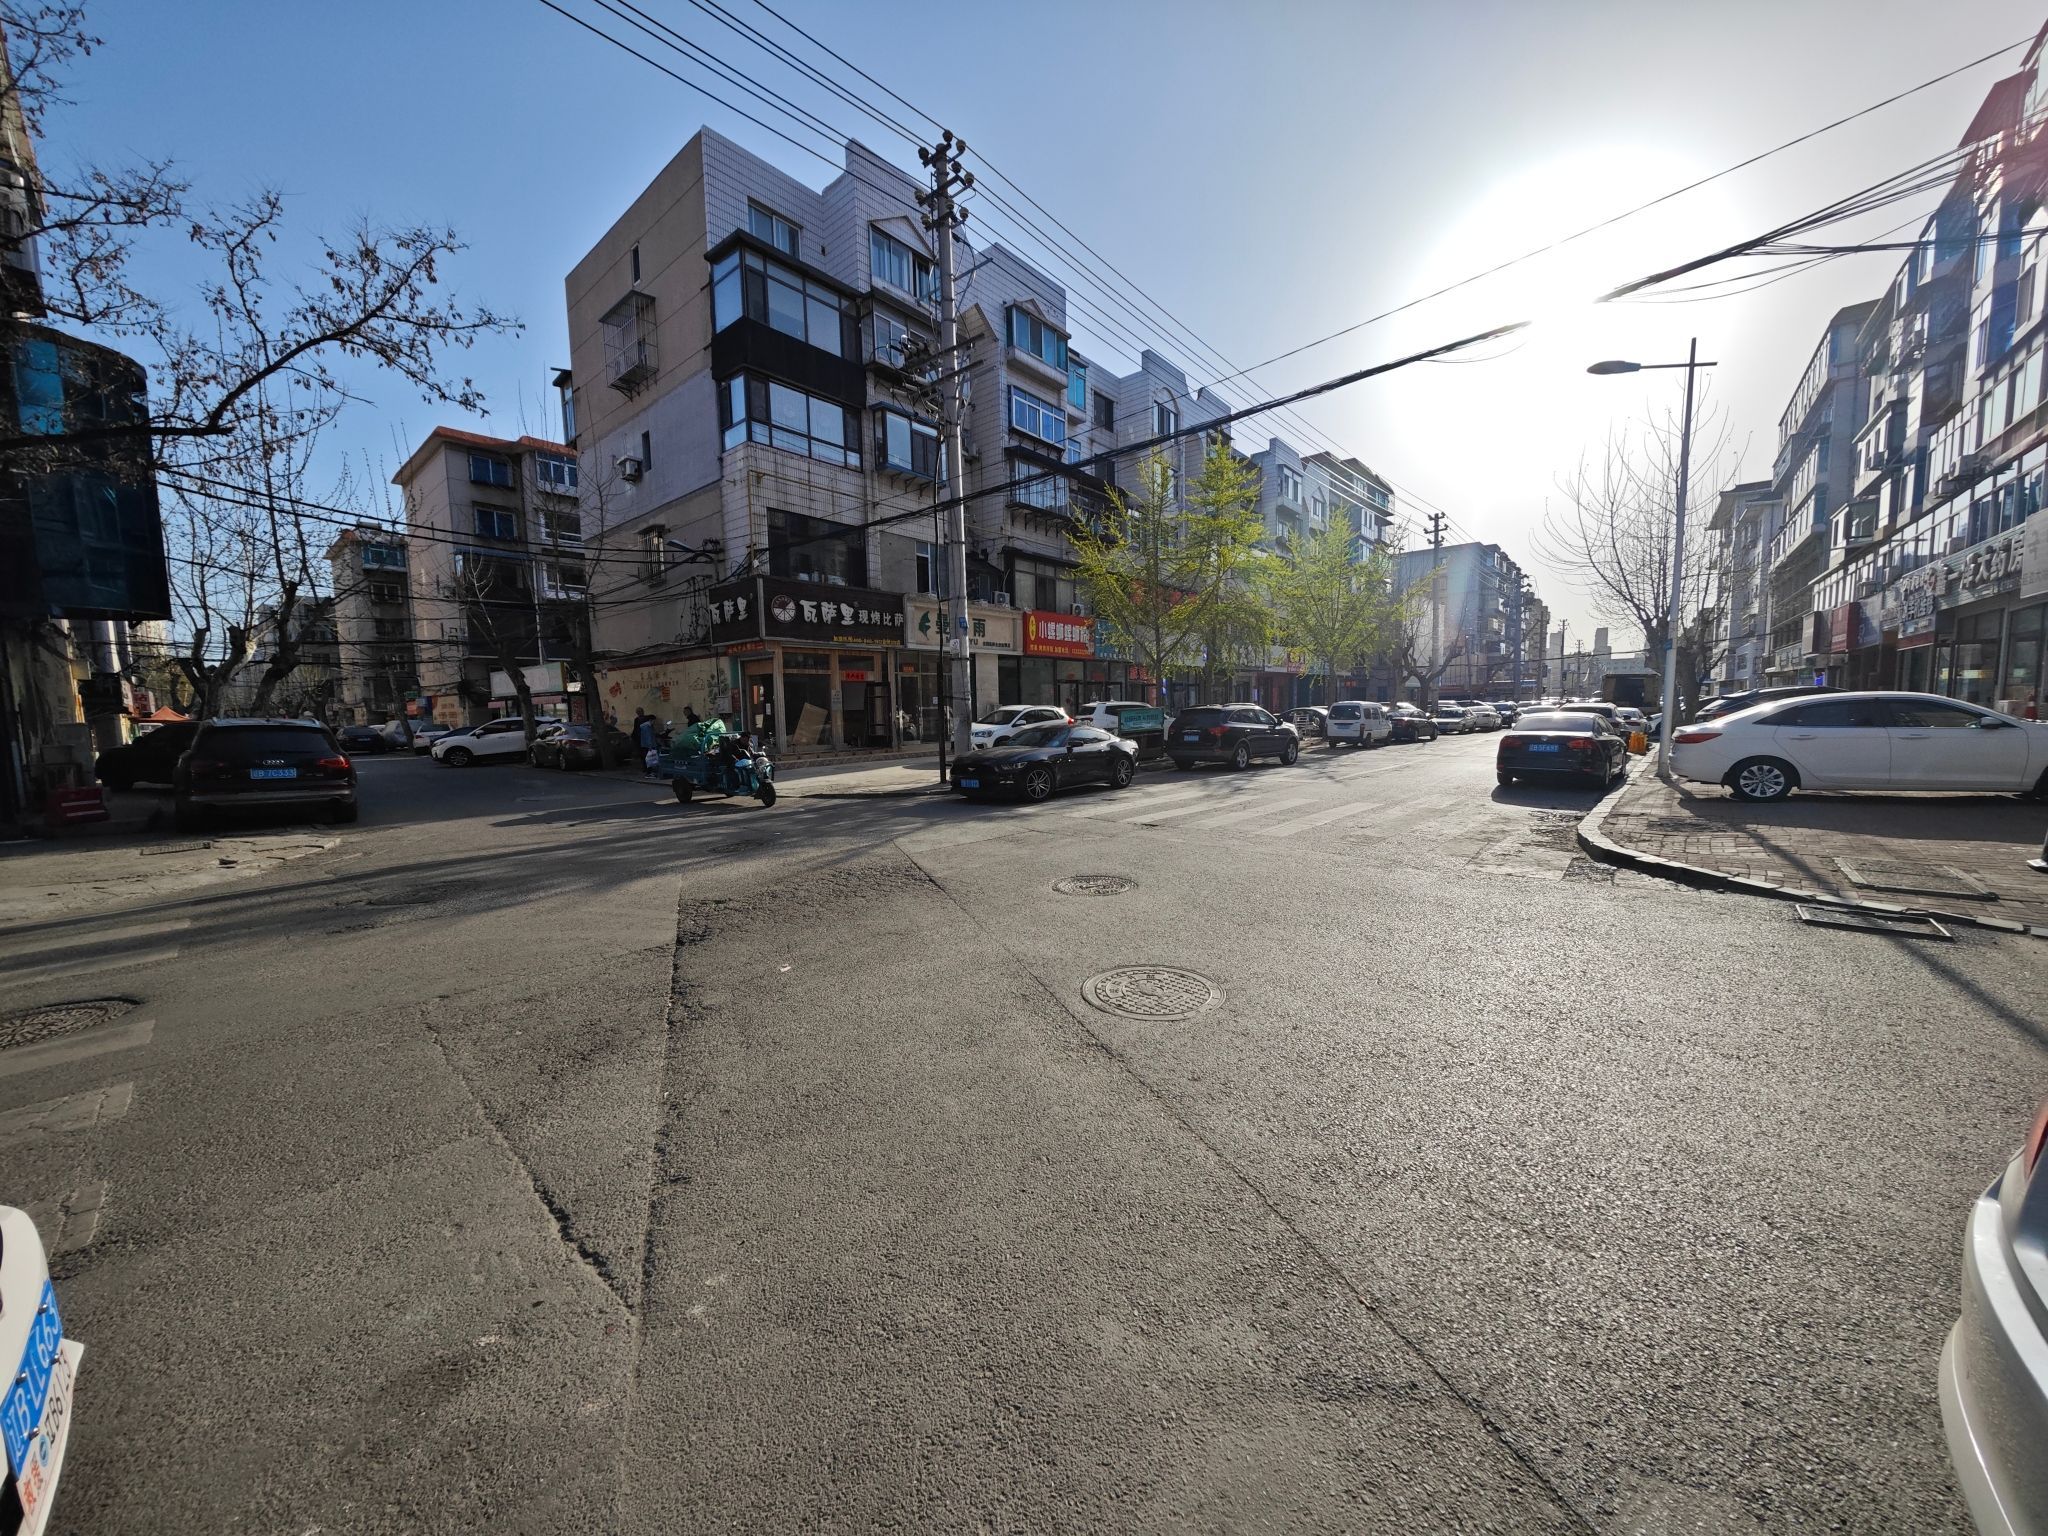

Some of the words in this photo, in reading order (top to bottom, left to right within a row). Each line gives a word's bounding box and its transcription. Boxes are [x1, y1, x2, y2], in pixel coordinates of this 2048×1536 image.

[709, 596, 748, 625] 瓦萨里
[799, 599, 855, 626] 瓦萨里
[857, 609, 904, 627] 现烤比萨
